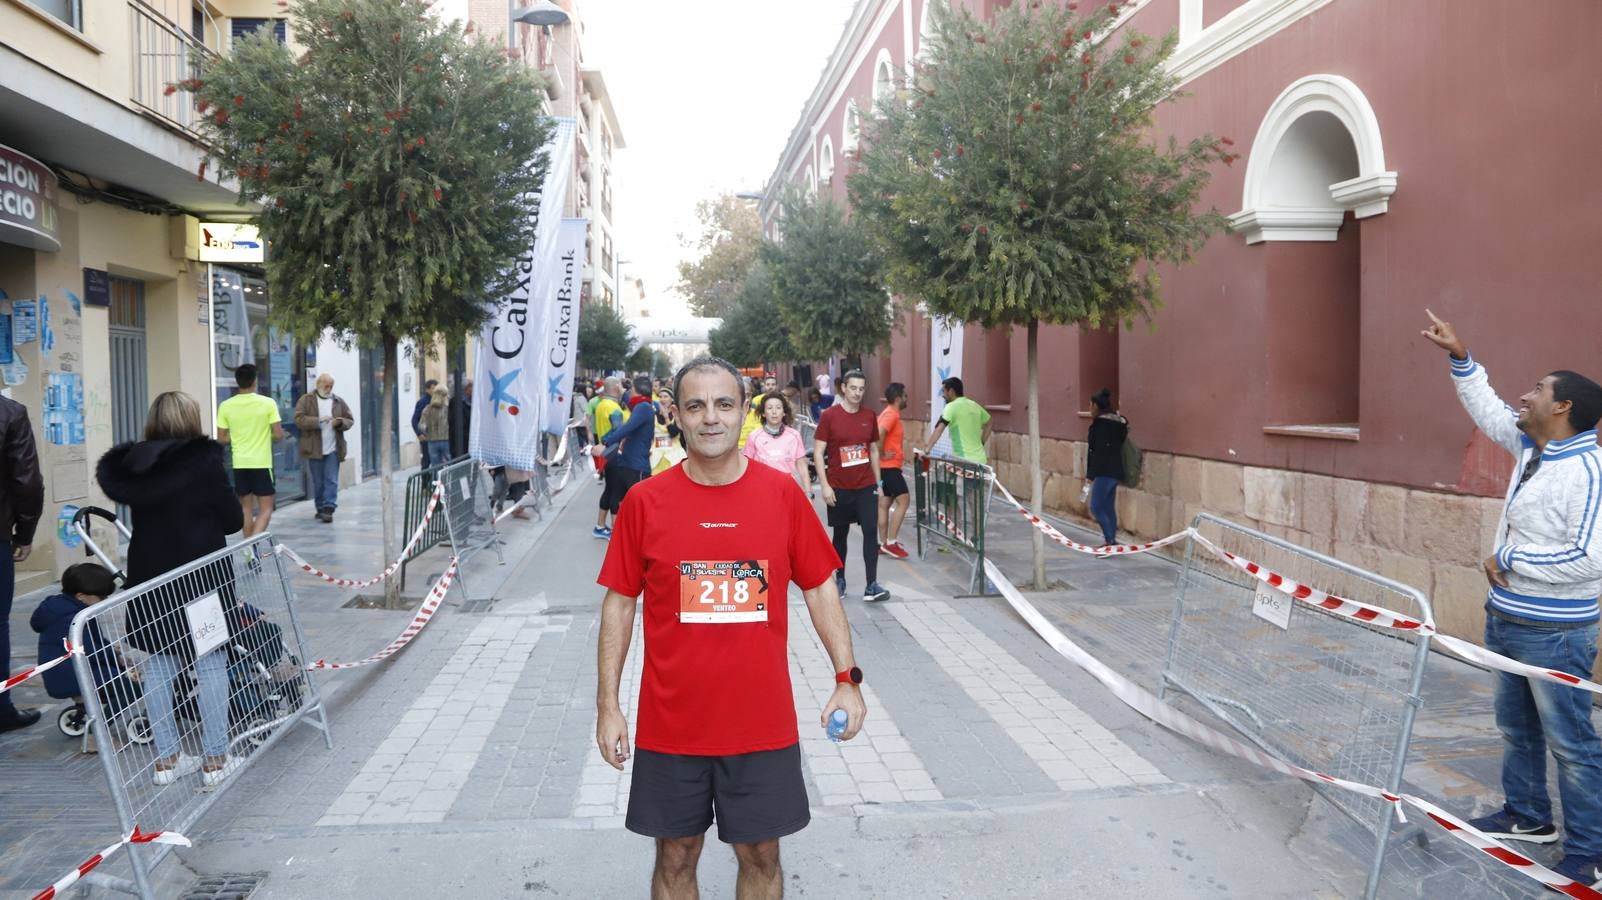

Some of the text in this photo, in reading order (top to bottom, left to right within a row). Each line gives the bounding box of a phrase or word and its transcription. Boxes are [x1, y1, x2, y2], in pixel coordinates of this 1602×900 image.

[550, 248, 575, 368] CaixaBank
[682, 564, 691, 574] VI
[732, 569, 763, 578] LORCA
[700, 580, 750, 604] 218
